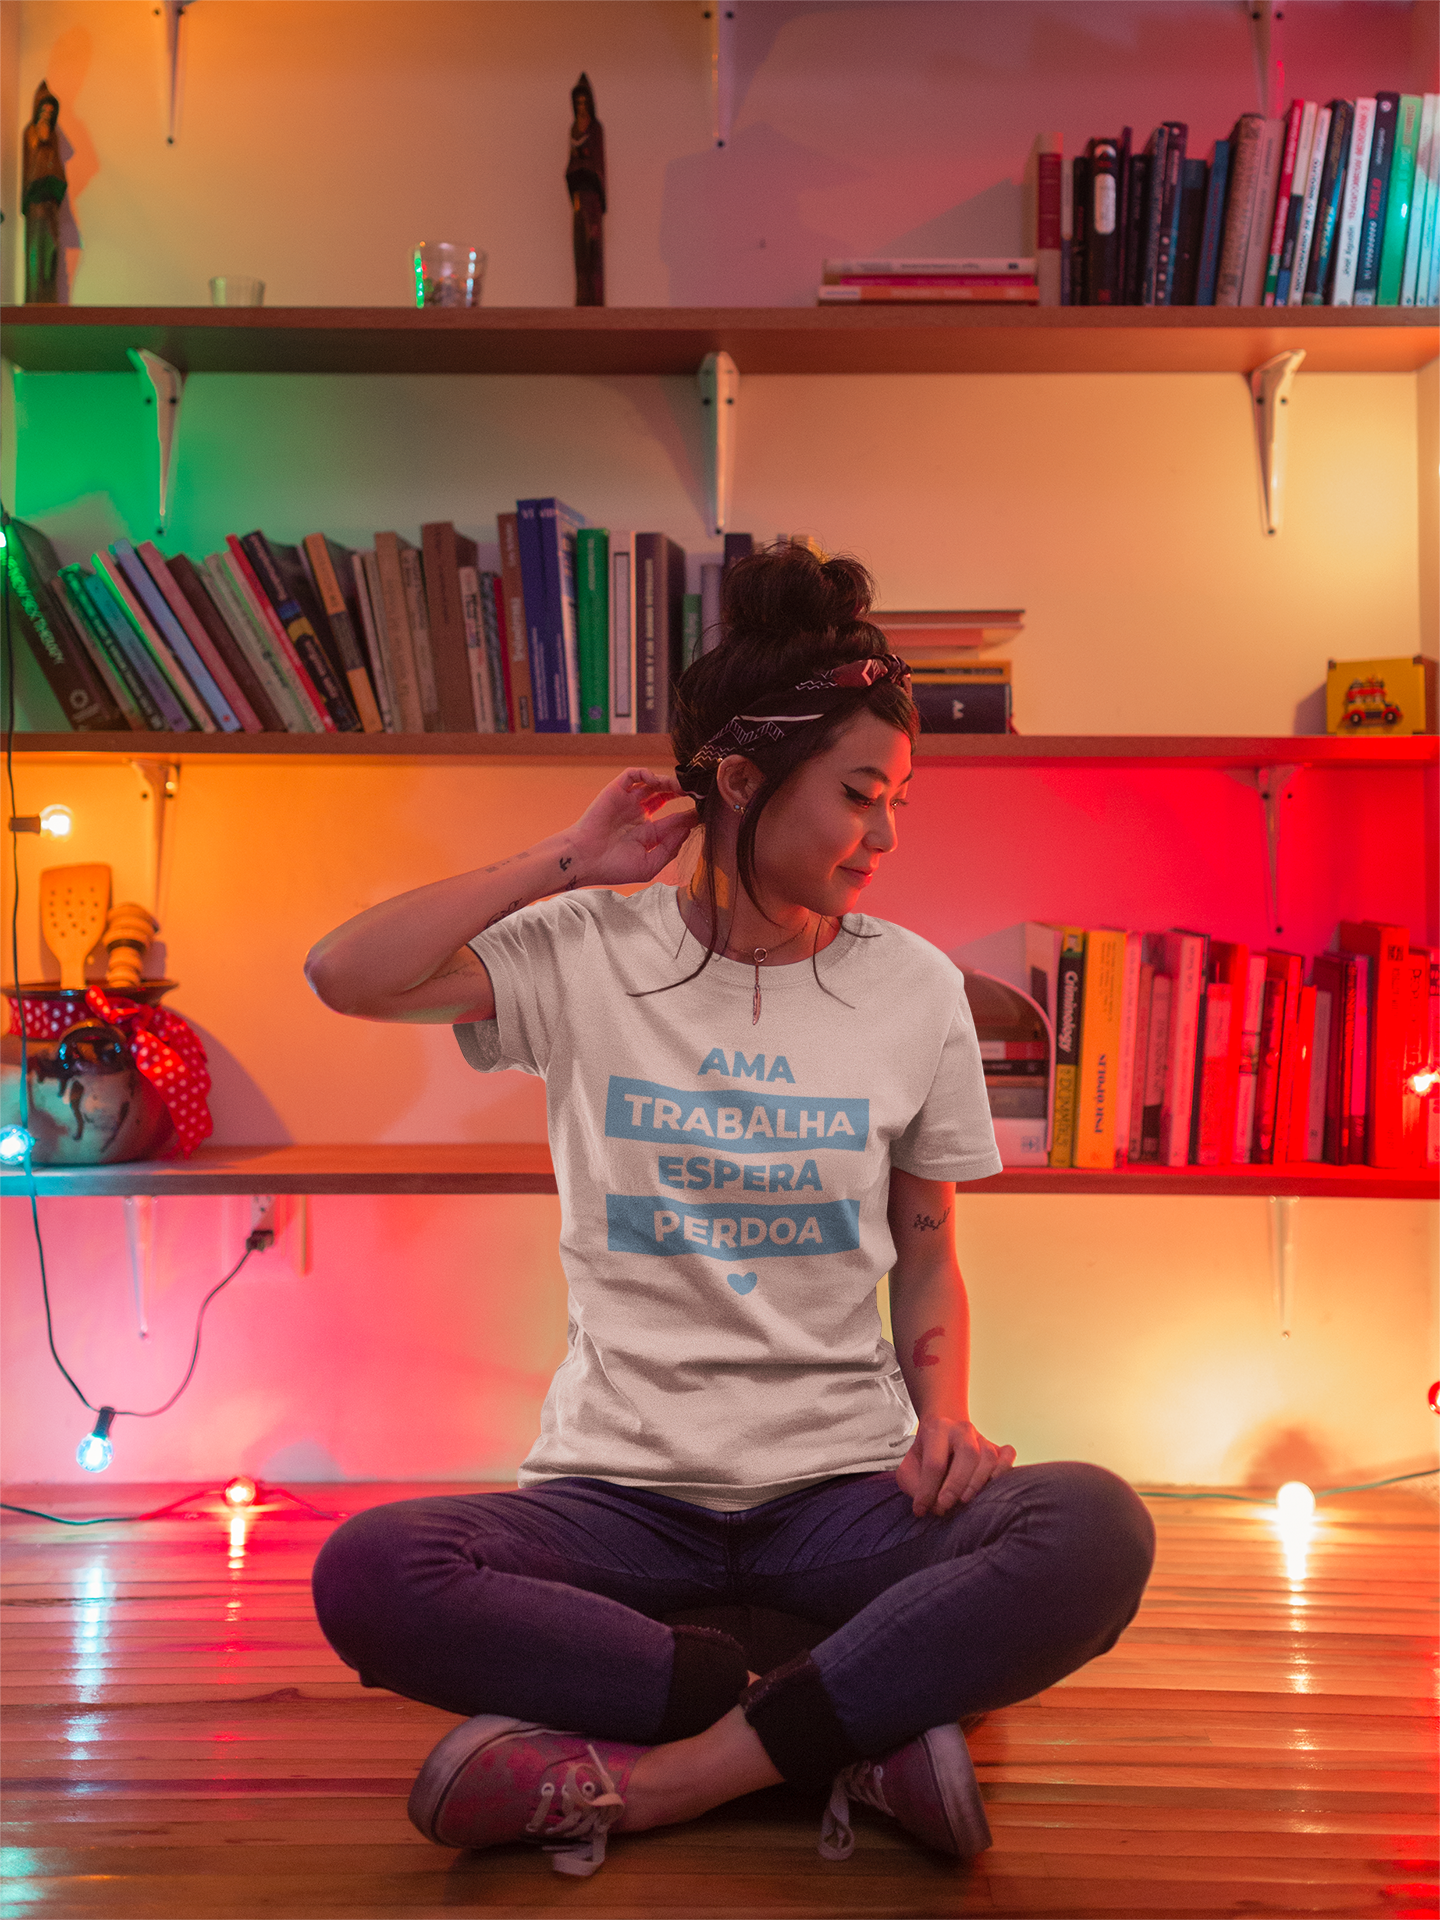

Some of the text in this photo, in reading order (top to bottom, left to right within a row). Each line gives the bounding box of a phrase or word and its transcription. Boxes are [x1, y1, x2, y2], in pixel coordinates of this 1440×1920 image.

[1058, 970, 1079, 1053] Criminology
[697, 1047, 796, 1084] AMA
[624, 1093, 856, 1140] TRABALHA
[658, 1155, 823, 1193] ESPERA
[653, 1210, 823, 1249] PERDOA
